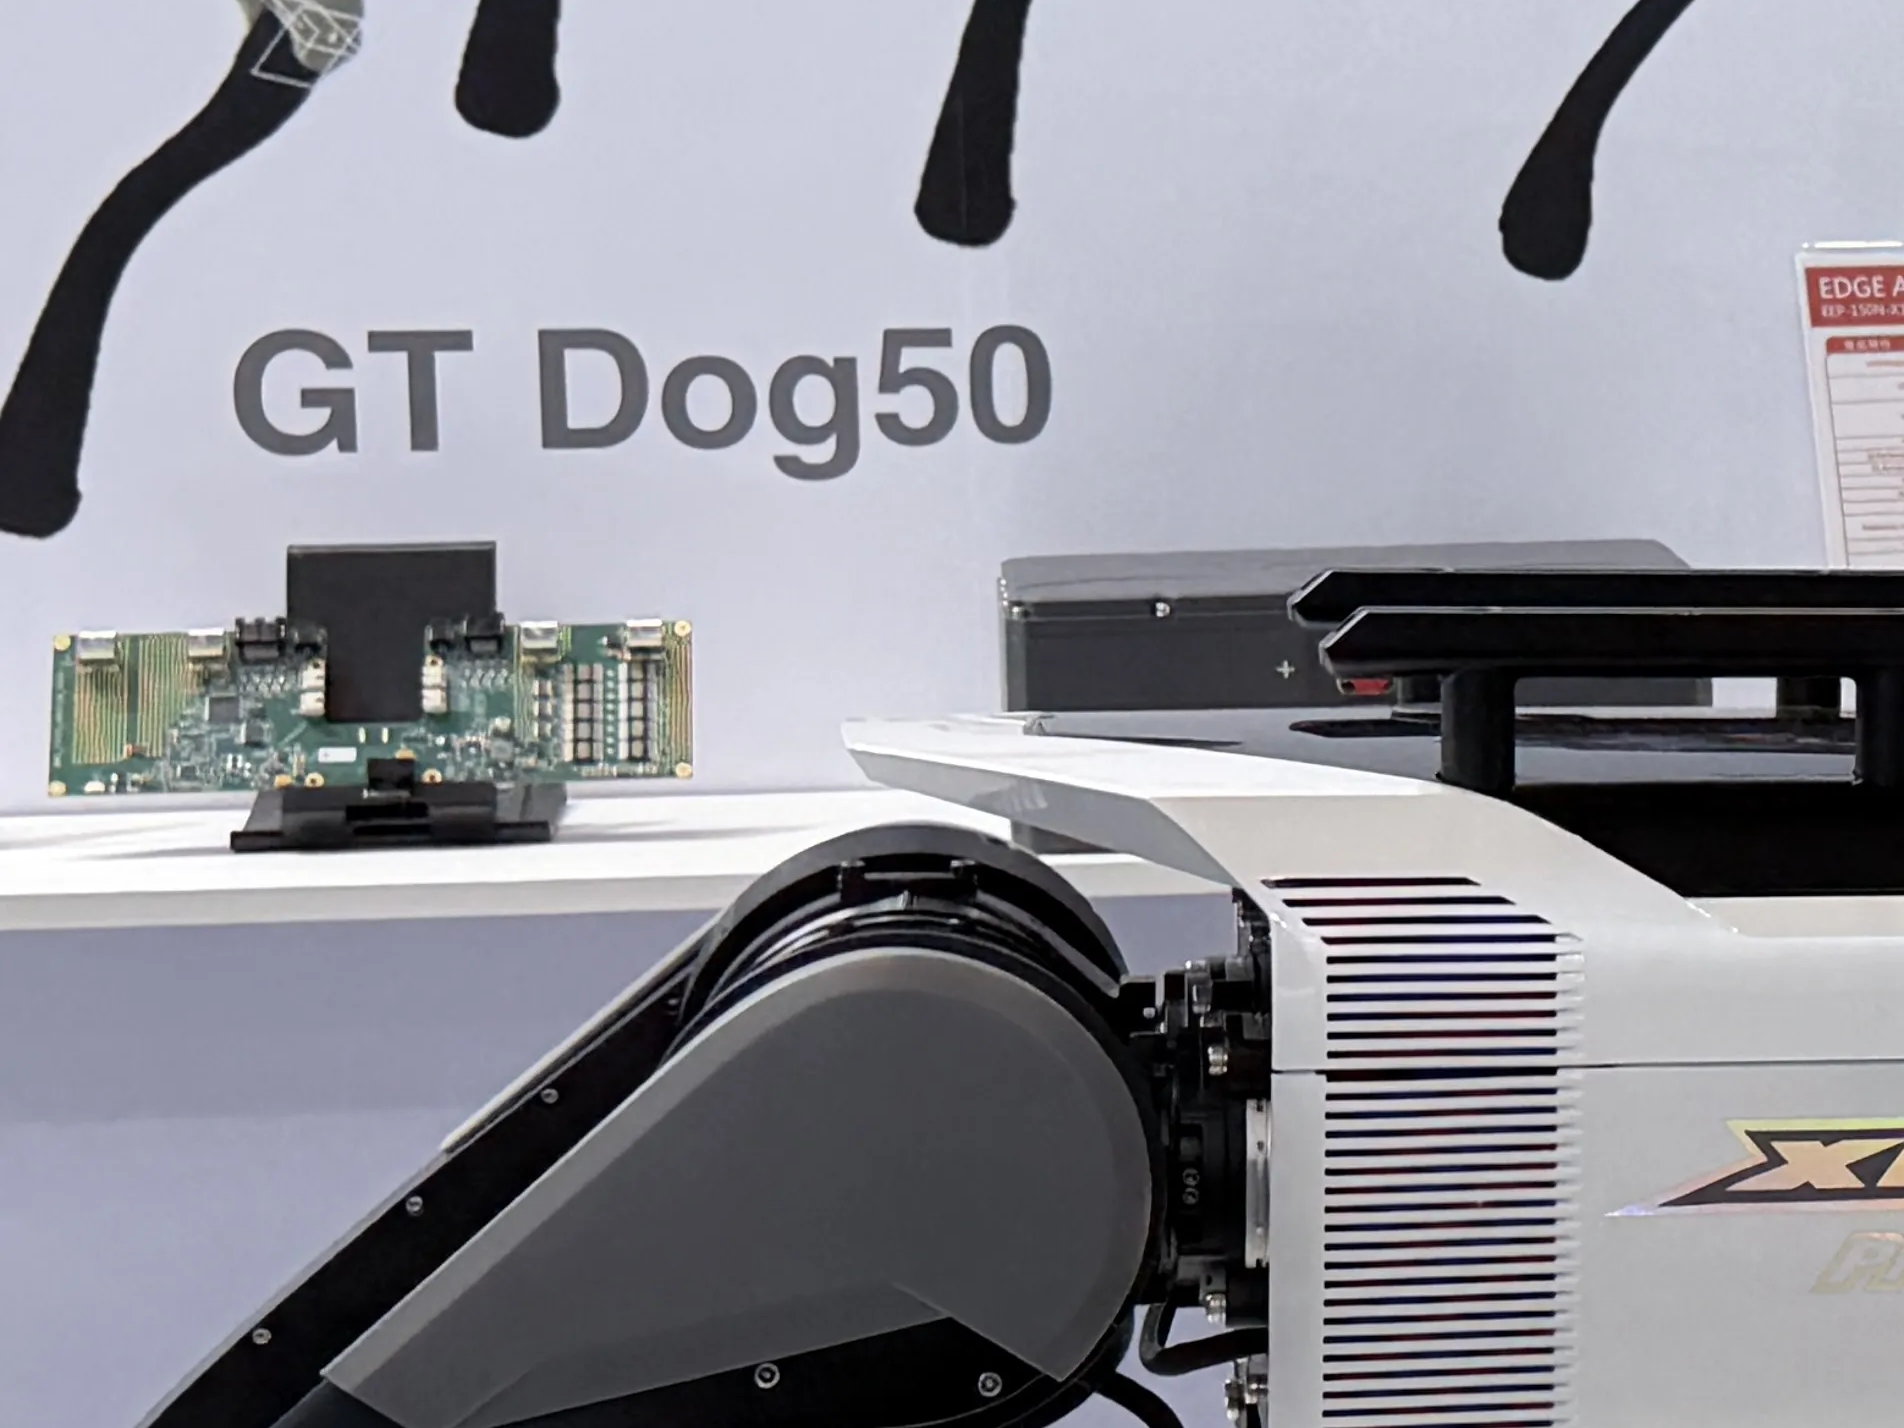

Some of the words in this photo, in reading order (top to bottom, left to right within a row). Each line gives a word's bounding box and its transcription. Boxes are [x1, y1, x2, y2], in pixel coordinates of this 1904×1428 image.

[1818, 274, 1887, 300] EDGE
[231, 328, 474, 455] GT
[537, 323, 1053, 481] Dog50
